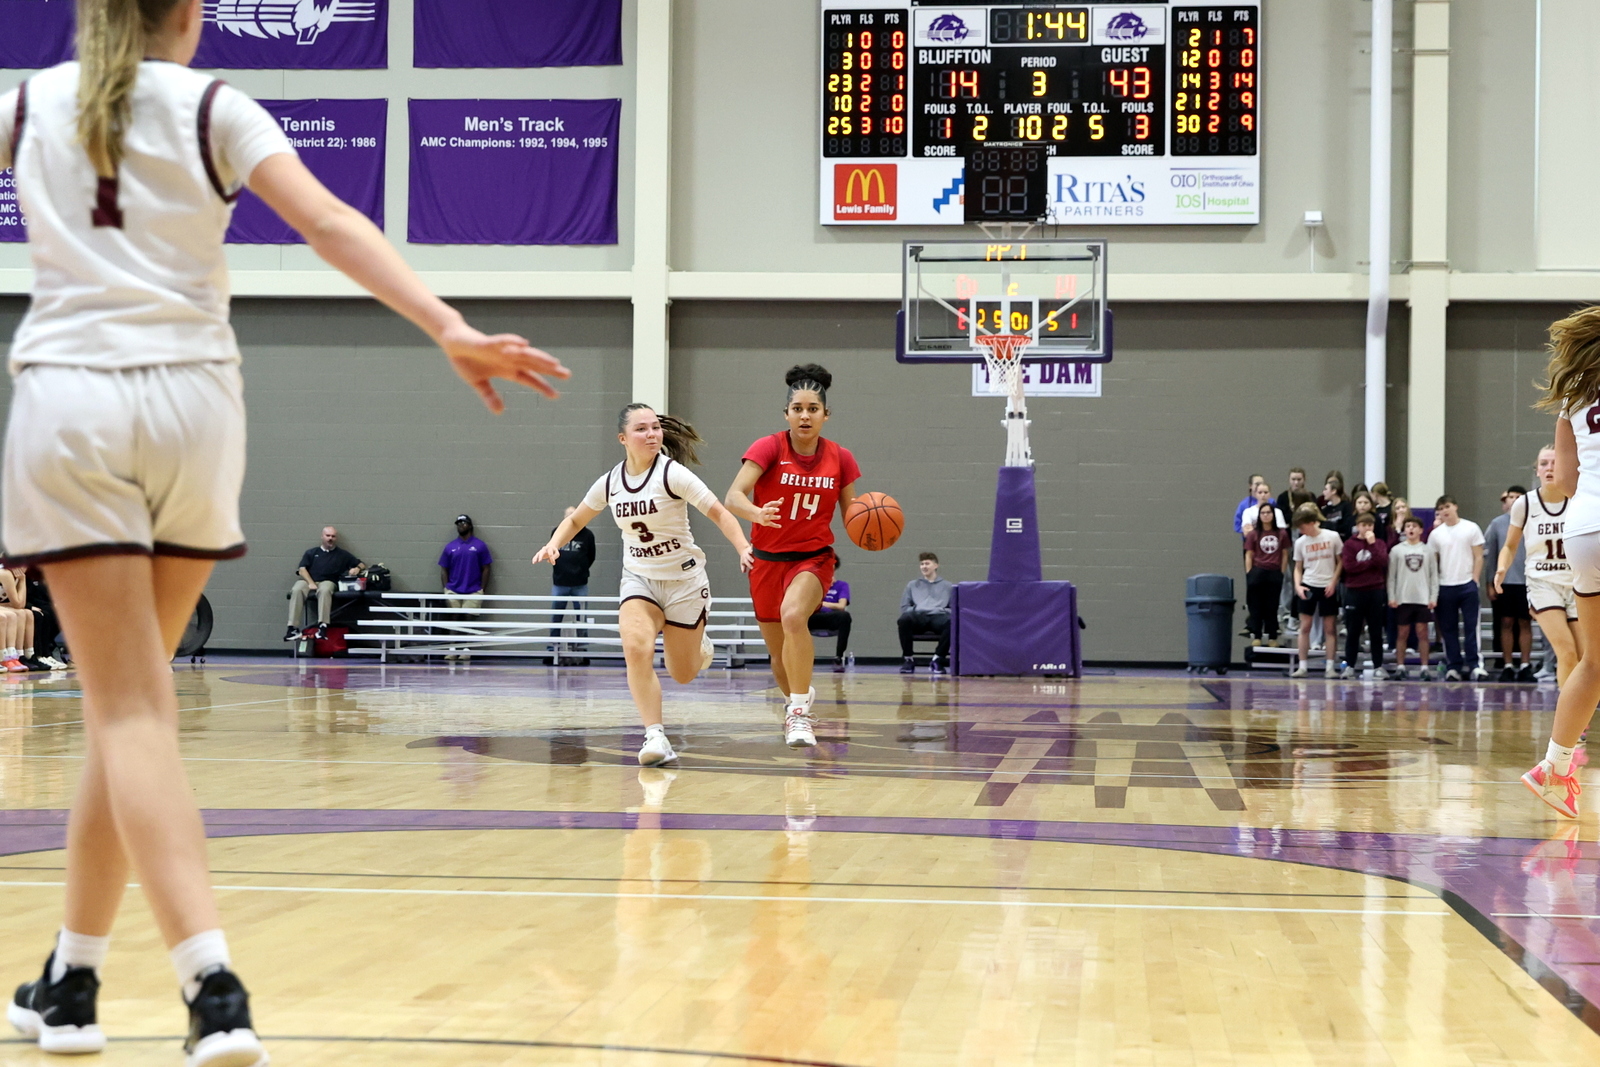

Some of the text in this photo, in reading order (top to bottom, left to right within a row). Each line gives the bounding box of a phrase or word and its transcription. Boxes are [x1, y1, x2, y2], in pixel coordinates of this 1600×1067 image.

[831, 13, 900, 25] PLYR FLS PTS
[1178, 10, 1249, 22] PLYR FLS PTS
[1027, 11, 1085, 40] 1:44
[848, 31, 904, 49] 1 0 0
[1189, 28, 1253, 47] 2 1 7
[842, 51, 904, 70] 3 0 0
[919, 49, 991, 65] BLUFFTON
[1021, 57, 1057, 68] PERIOD
[1101, 47, 1150, 63] GUEST
[1182, 48, 1253, 68] 12 0 0
[828, 74, 904, 92] 23 2 1
[951, 70, 978, 98] 14
[1032, 71, 1047, 97] 3
[1109, 67, 1150, 98] 43
[1182, 72, 1253, 90] 14 3 14
[834, 94, 904, 112] 10 2 0
[924, 102, 1154, 115] FOULS T.O.L. PLAYER FOUL T.O.L. FOULS
[1175, 91, 1253, 111] 21 2 9
[281, 117, 336, 132] Tennis
[464, 117, 565, 132] Men's Track
[828, 116, 904, 134] 25 3 10
[946, 114, 1149, 140] 1 2 10 2 5 3
[1176, 114, 1253, 133] 30 2 9
[350, 137, 376, 148] 1986
[420, 137, 608, 149] AMC Champions: 1992, 1994, 1995
[924, 145, 956, 156] SCORE
[1121, 144, 1154, 155] SCORE
[1170, 174, 1197, 188] OIO
[836, 204, 895, 215] Lewis Family
[1175, 194, 1201, 208] IOS
[1207, 197, 1249, 207] Hospital
[1064, 205, 1144, 216] PARTNERS
[1039, 363, 1092, 384] DAM
[780, 472, 835, 490] BELLEVUE
[615, 498, 658, 518] GENOA
[789, 492, 821, 521] 14
[631, 521, 655, 543] 3
[629, 538, 682, 558] COMETS
